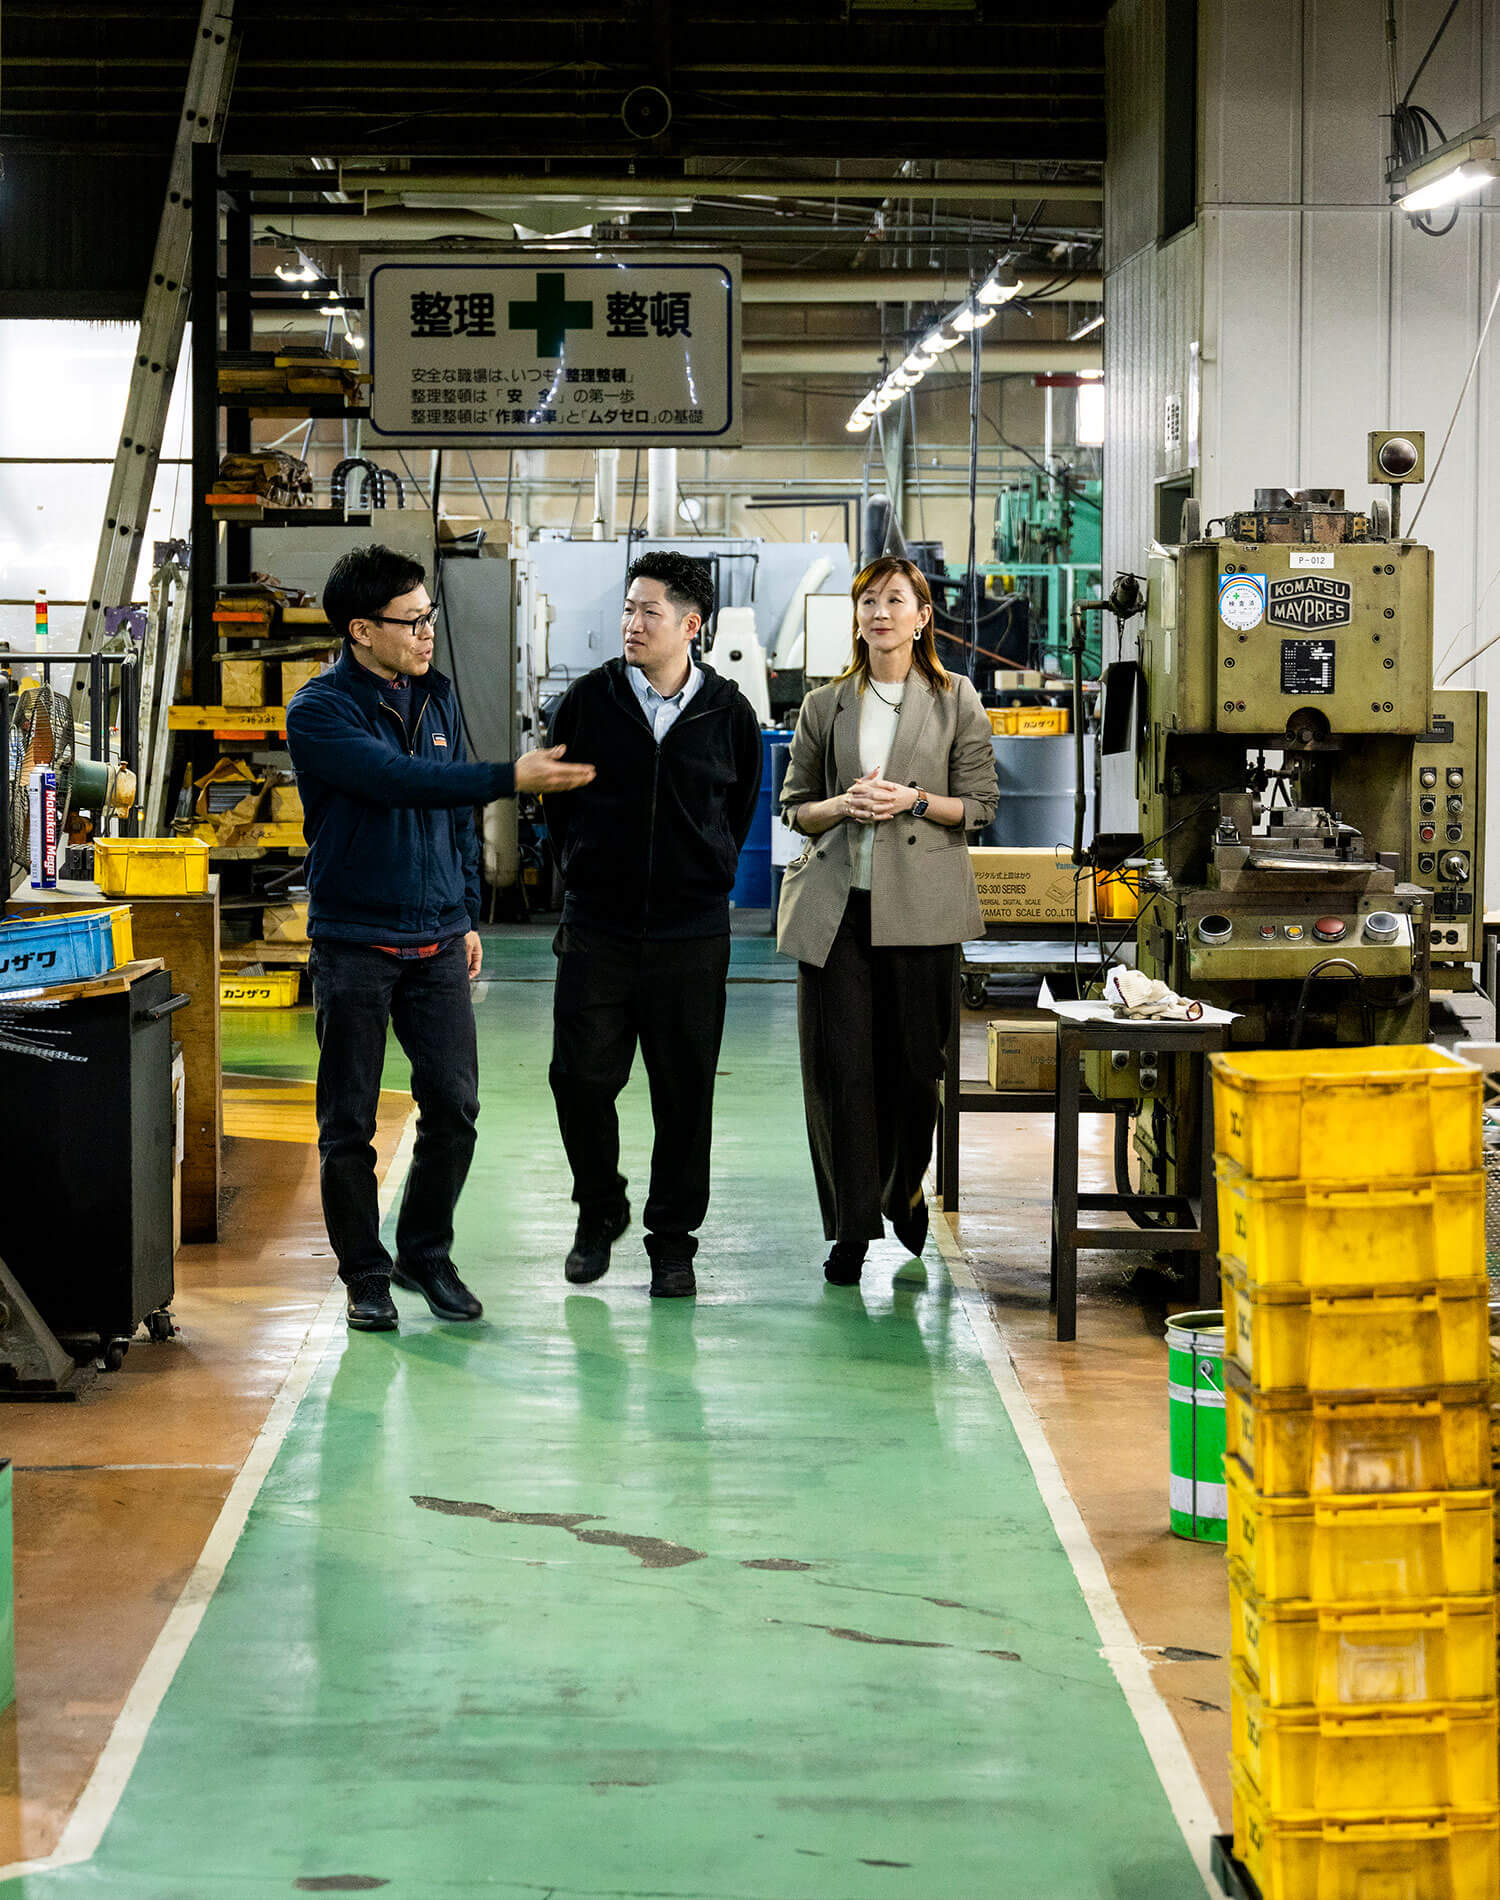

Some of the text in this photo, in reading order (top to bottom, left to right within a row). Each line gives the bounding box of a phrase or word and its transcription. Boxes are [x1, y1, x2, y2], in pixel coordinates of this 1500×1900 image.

[410, 291, 692, 338] 整理 整頓
[411, 367, 634, 384] 安全な職場は、いつも整理整頓」
[1298, 556, 1326, 565] P-012
[1274, 578, 1346, 597] KOMATSU
[1274, 599, 1346, 624] MAYPRES
[976, 884, 1027, 895] DS-300 SERIES
[1015, 908, 1041, 917] SCALE
[223, 989, 271, 999] カンザワ
